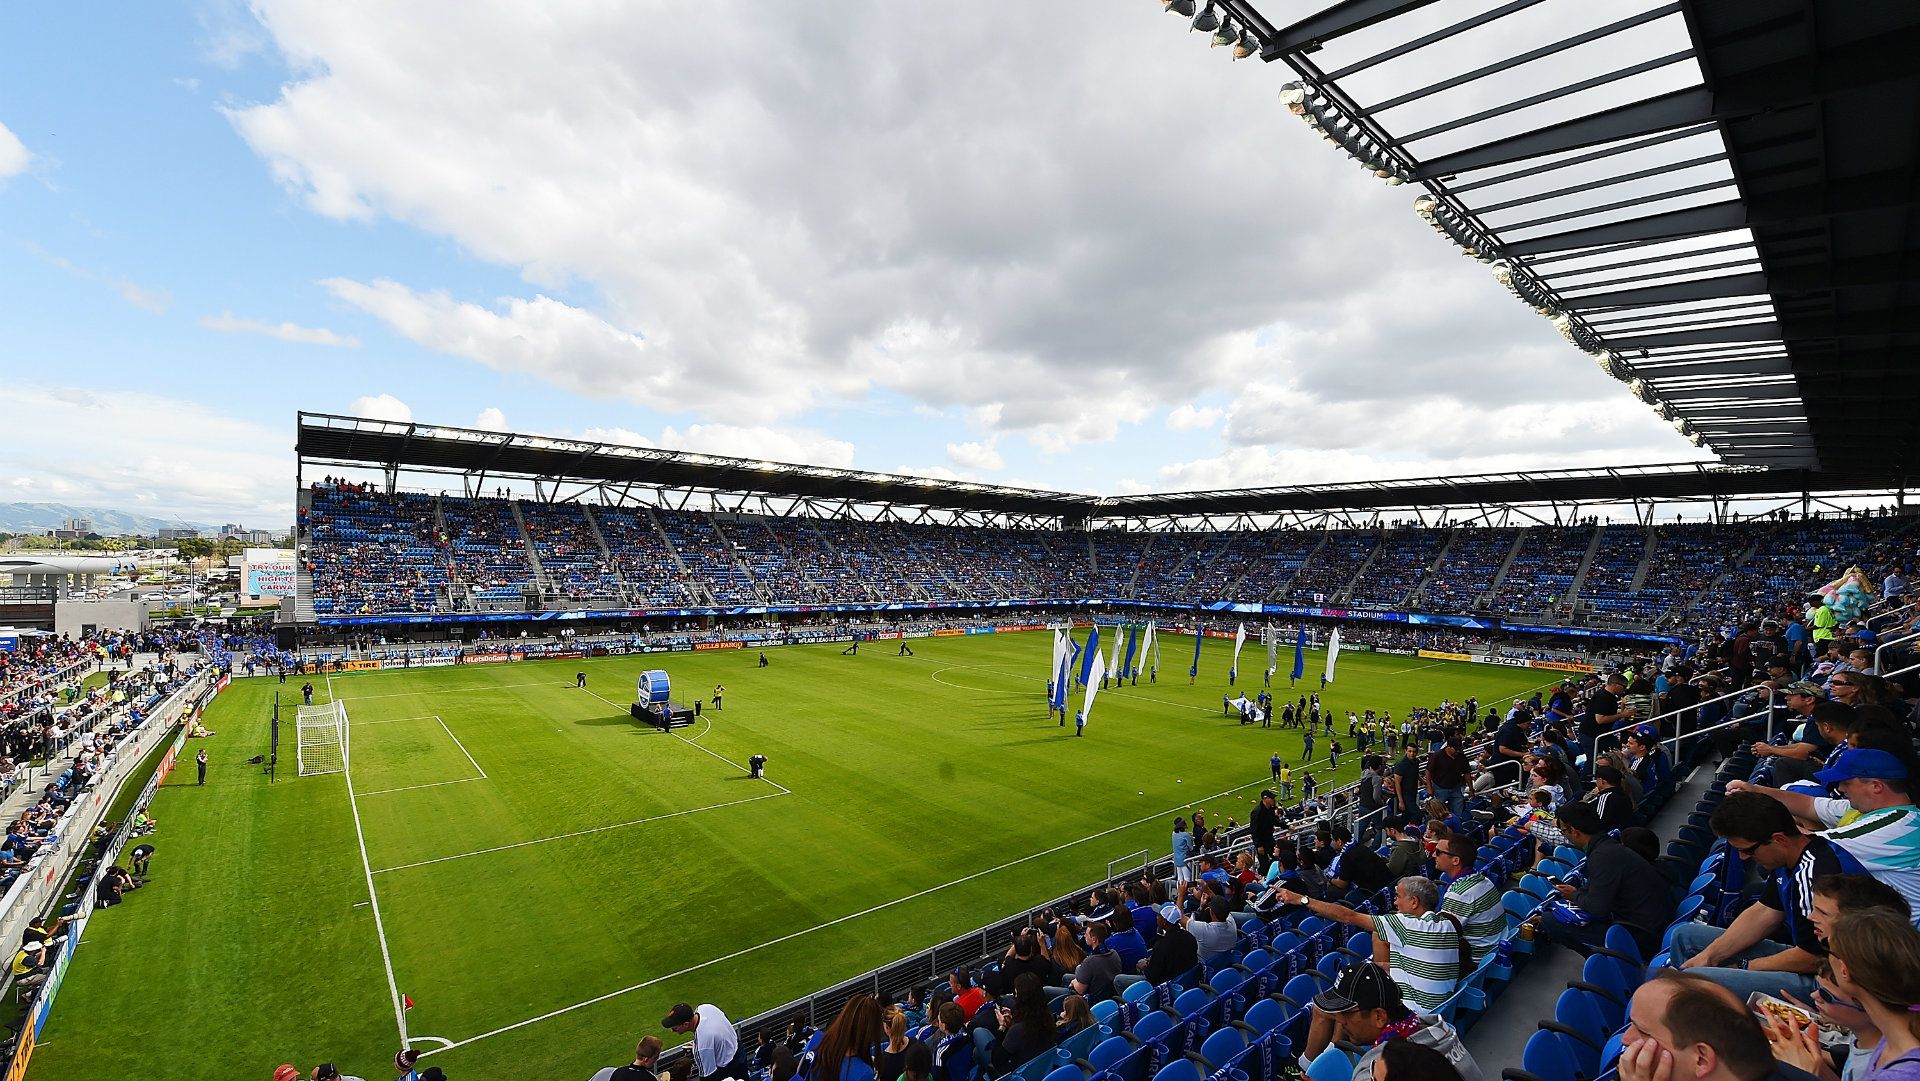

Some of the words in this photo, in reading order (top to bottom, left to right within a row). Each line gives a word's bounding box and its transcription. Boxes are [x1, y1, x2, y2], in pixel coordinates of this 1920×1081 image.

[1282, 606, 1309, 614] WELCOME
[1347, 610, 1384, 619] STADIUM
[901, 631, 928, 639] Heineken
[696, 642, 719, 650] WELLS
[720, 641, 743, 649] FARGO
[761, 639, 783, 647] adidas
[467, 653, 522, 664] #LetsDoGamDay
[1531, 659, 1568, 669] Continental
